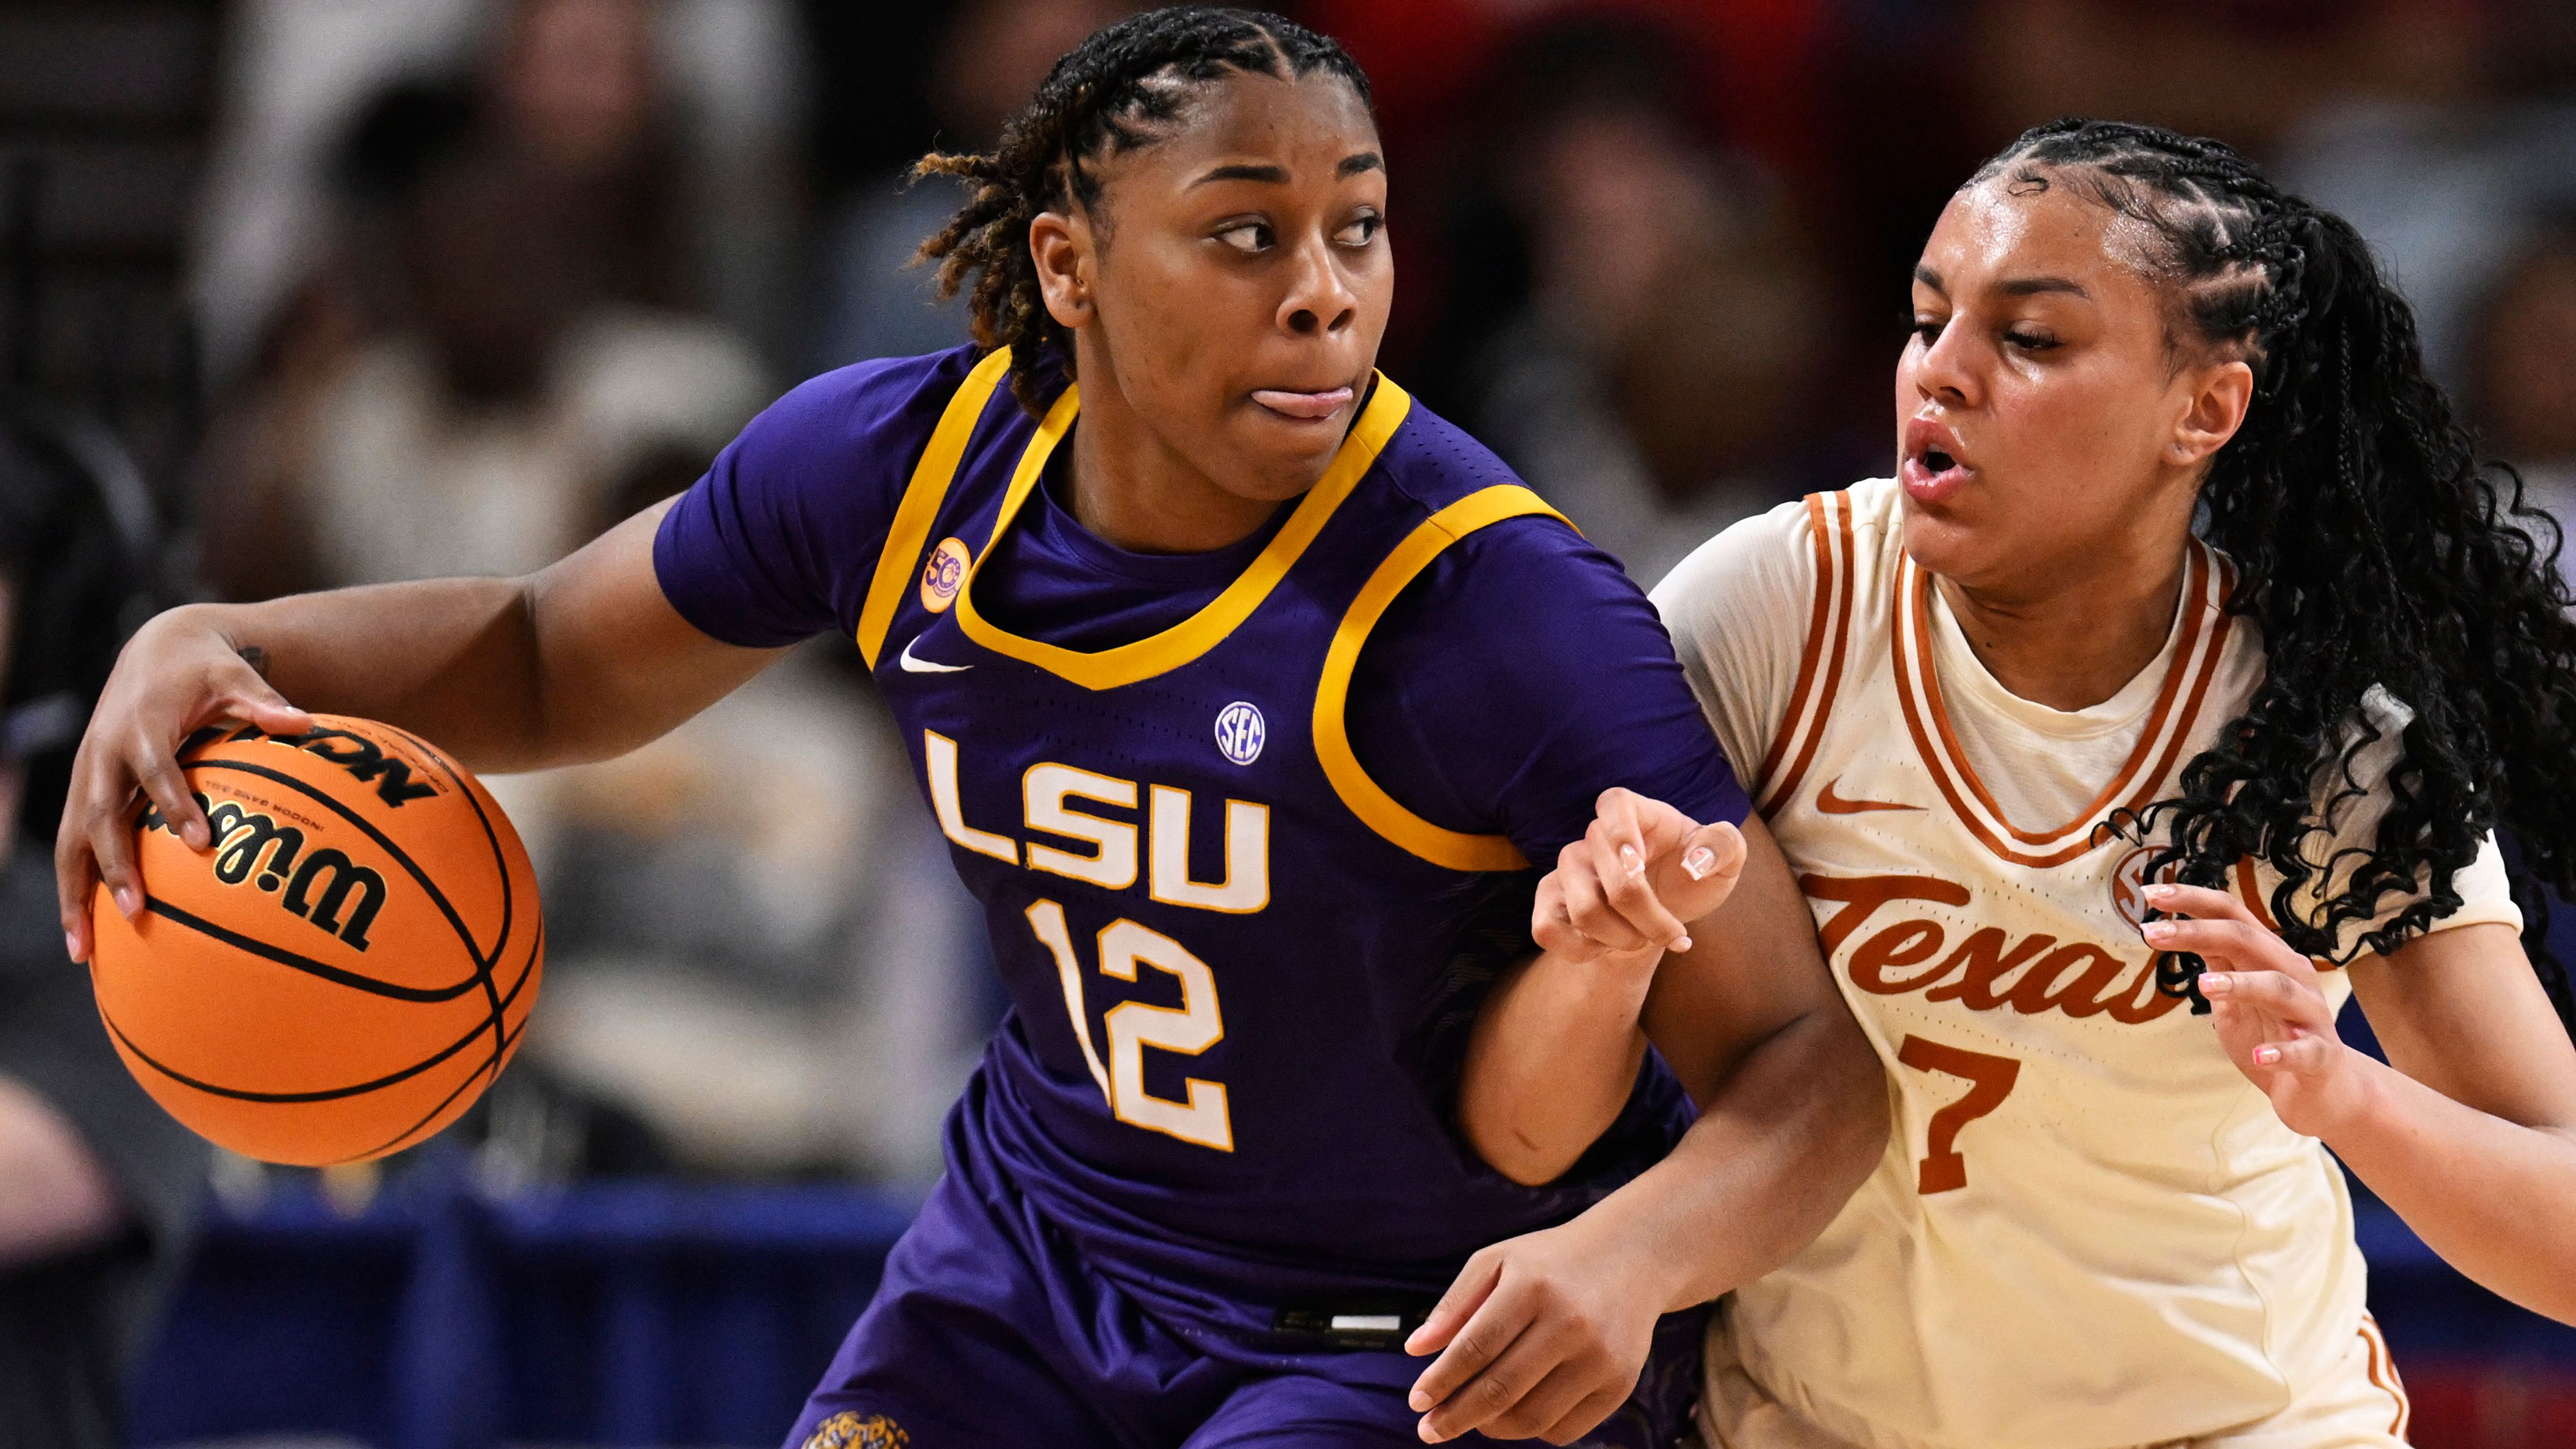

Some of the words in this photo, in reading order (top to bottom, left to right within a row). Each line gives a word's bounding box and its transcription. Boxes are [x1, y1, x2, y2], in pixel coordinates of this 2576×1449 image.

[1220, 707, 1262, 759] SEC
[135, 791, 387, 953] Wilsn
[924, 728, 1270, 914] LSU
[1025, 897, 1235, 1153] 12
[1800, 873, 2194, 1025] Texas
[1898, 1034, 2022, 1195] 7
